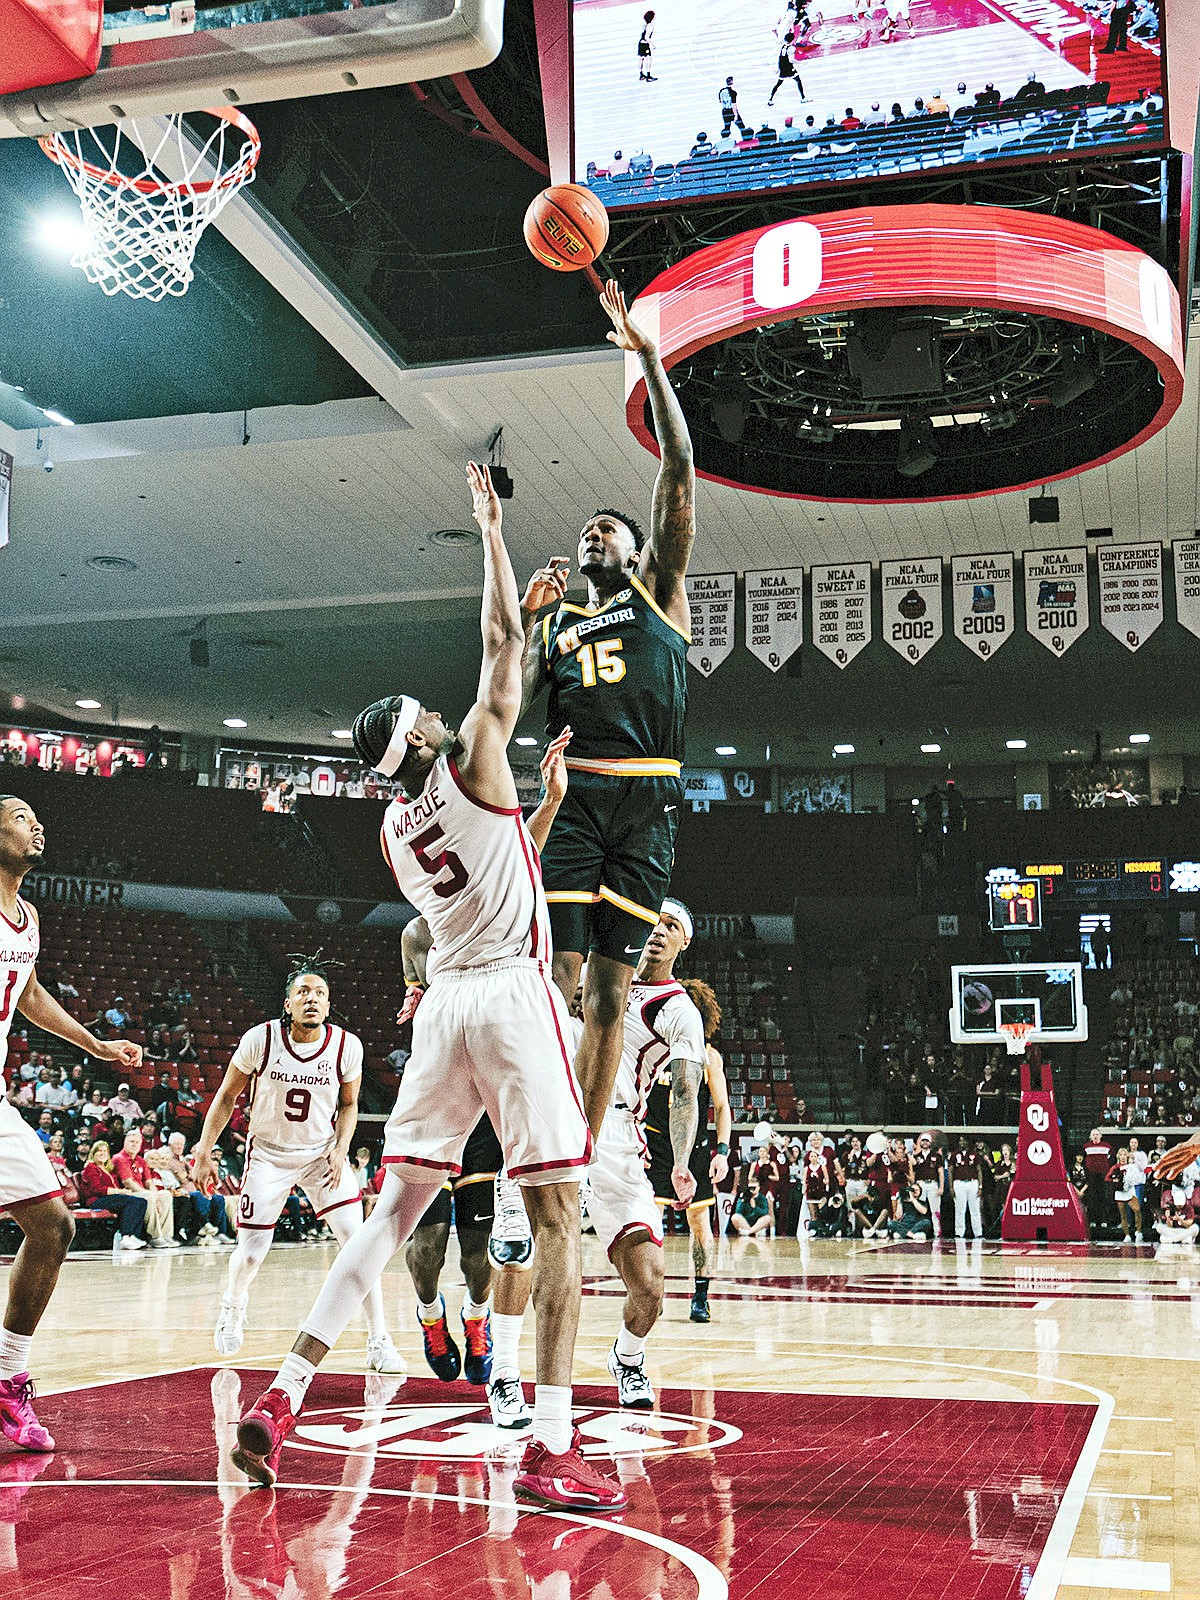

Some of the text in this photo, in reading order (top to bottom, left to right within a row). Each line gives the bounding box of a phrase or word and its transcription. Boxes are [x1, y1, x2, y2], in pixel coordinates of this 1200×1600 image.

[543, 216, 581, 256] ELITE
[1043, 554, 1069, 565] NCAA
[1100, 549, 1160, 561] CONFERENCE
[899, 564, 925, 575] NCAA
[970, 560, 996, 570] NCAA
[1028, 563, 1084, 577] FINAL FOUR
[1103, 559, 1158, 571] CHAMPIONS
[827, 569, 856, 581] NCAA
[885, 573, 939, 587] FINAL FOUR
[956, 569, 1011, 581] FINAL FOUR
[693, 579, 720, 591] NCAA
[760, 576, 787, 588] NCAA
[817, 579, 866, 593] SWEET 16
[1122, 580, 1139, 588] 2000
[1142, 578, 1158, 587] 2001
[747, 587, 801, 598] TOURNAMENT
[1103, 590, 1158, 601] 2002 2006 2007
[709, 603, 728, 613] 2008
[752, 600, 796, 612] 2016 2023
[820, 597, 864, 609] 1986 2007
[1104, 602, 1159, 613] 2009 2023 2024
[709, 614, 727, 624] 2012
[752, 611, 797, 623] 2017 2024
[819, 609, 863, 621] 2000 2011
[1038, 609, 1077, 629] 2010
[709, 625, 728, 636] 2014
[752, 624, 769, 634] 2018
[820, 620, 864, 632] 2001 2013
[892, 620, 934, 641] 2002
[963, 614, 1006, 635] 2009
[556, 607, 636, 656] MISSOURI
[819, 632, 865, 643] 2006 2025
[709, 636, 727, 647] 2015
[751, 635, 771, 645] 2022
[576, 637, 627, 688] 15
[37, 743, 62, 772] 10
[408, 822, 470, 899] 5
[1026, 864, 1064, 876] OKLAHOMA
[1124, 861, 1161, 874] MISSOURI
[20, 875, 123, 904] SOONER
[1045, 877, 1053, 894] 3
[1150, 873, 1161, 891] 0
[1009, 898, 1034, 924] 17
[0, 949, 38, 963] KLAHOM
[270, 1070, 331, 1086] OKLAHOMA
[284, 1087, 312, 1122] 9
[1026, 1103, 1050, 1132] OU
[240, 1193, 255, 1219] OU
[1030, 1206, 1055, 1216] BANK
